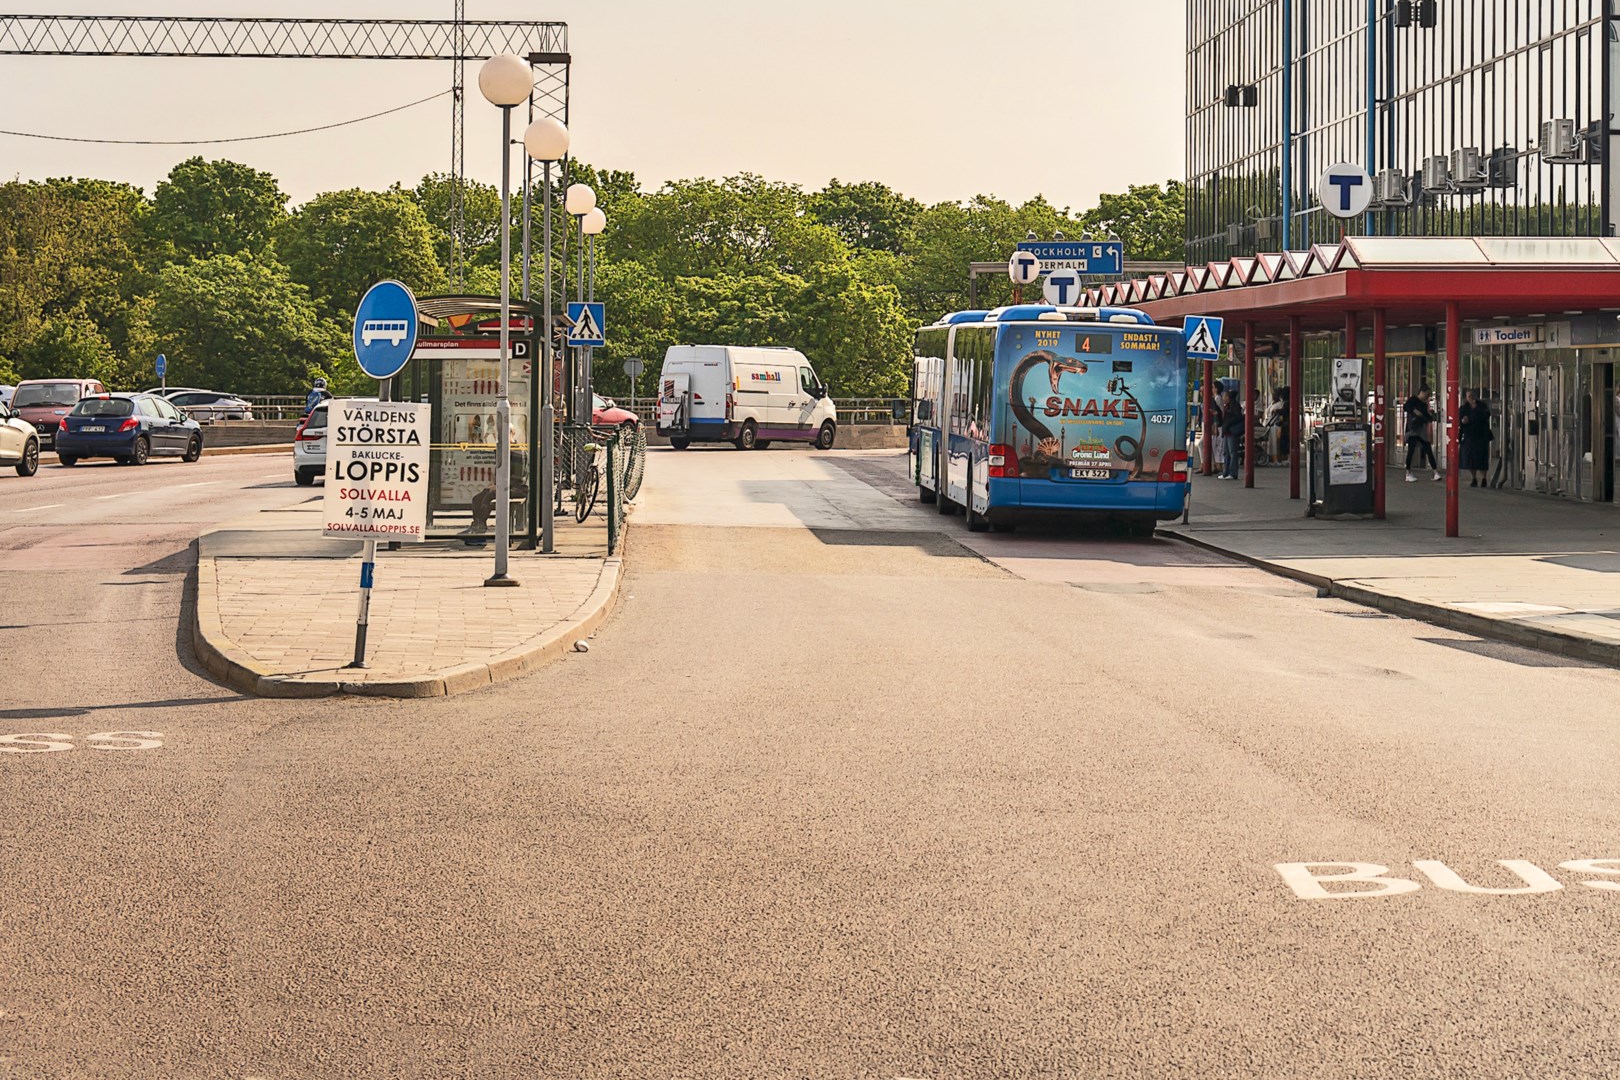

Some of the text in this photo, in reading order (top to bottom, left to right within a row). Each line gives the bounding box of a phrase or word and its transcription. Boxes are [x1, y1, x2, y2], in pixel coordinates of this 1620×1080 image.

[1330, 175, 1362, 210] T
[1094, 248, 1100, 256] C
[1018, 259, 1034, 279] T
[1051, 277, 1074, 304] T
[1035, 330, 1061, 339] NYHET
[1123, 333, 1153, 342] ENDAST
[1494, 329, 1531, 341] Toalett
[416, 340, 459, 349] ullmarsplan
[1037, 339, 1058, 347] 2019
[1082, 337, 1090, 352] 4
[1120, 341, 1160, 351] SOMMAR!
[515, 343, 527, 356] D
[751, 371, 781, 382] samhall
[1044, 396, 1138, 419] SNAKE
[343, 408, 416, 423] VÄRLDENS
[1150, 415, 1173, 424] 4037
[337, 423, 420, 444] STÖRSTA
[352, 451, 404, 460] BAKLUCKE-
[1072, 450, 1110, 459] Gröna Lund
[335, 461, 420, 483] LOPPIS
[340, 488, 411, 501] SOLVALLA
[345, 507, 403, 520] 4-5 MAJ
[327, 522, 420, 534] SOLVALLALOPPIS.SE
